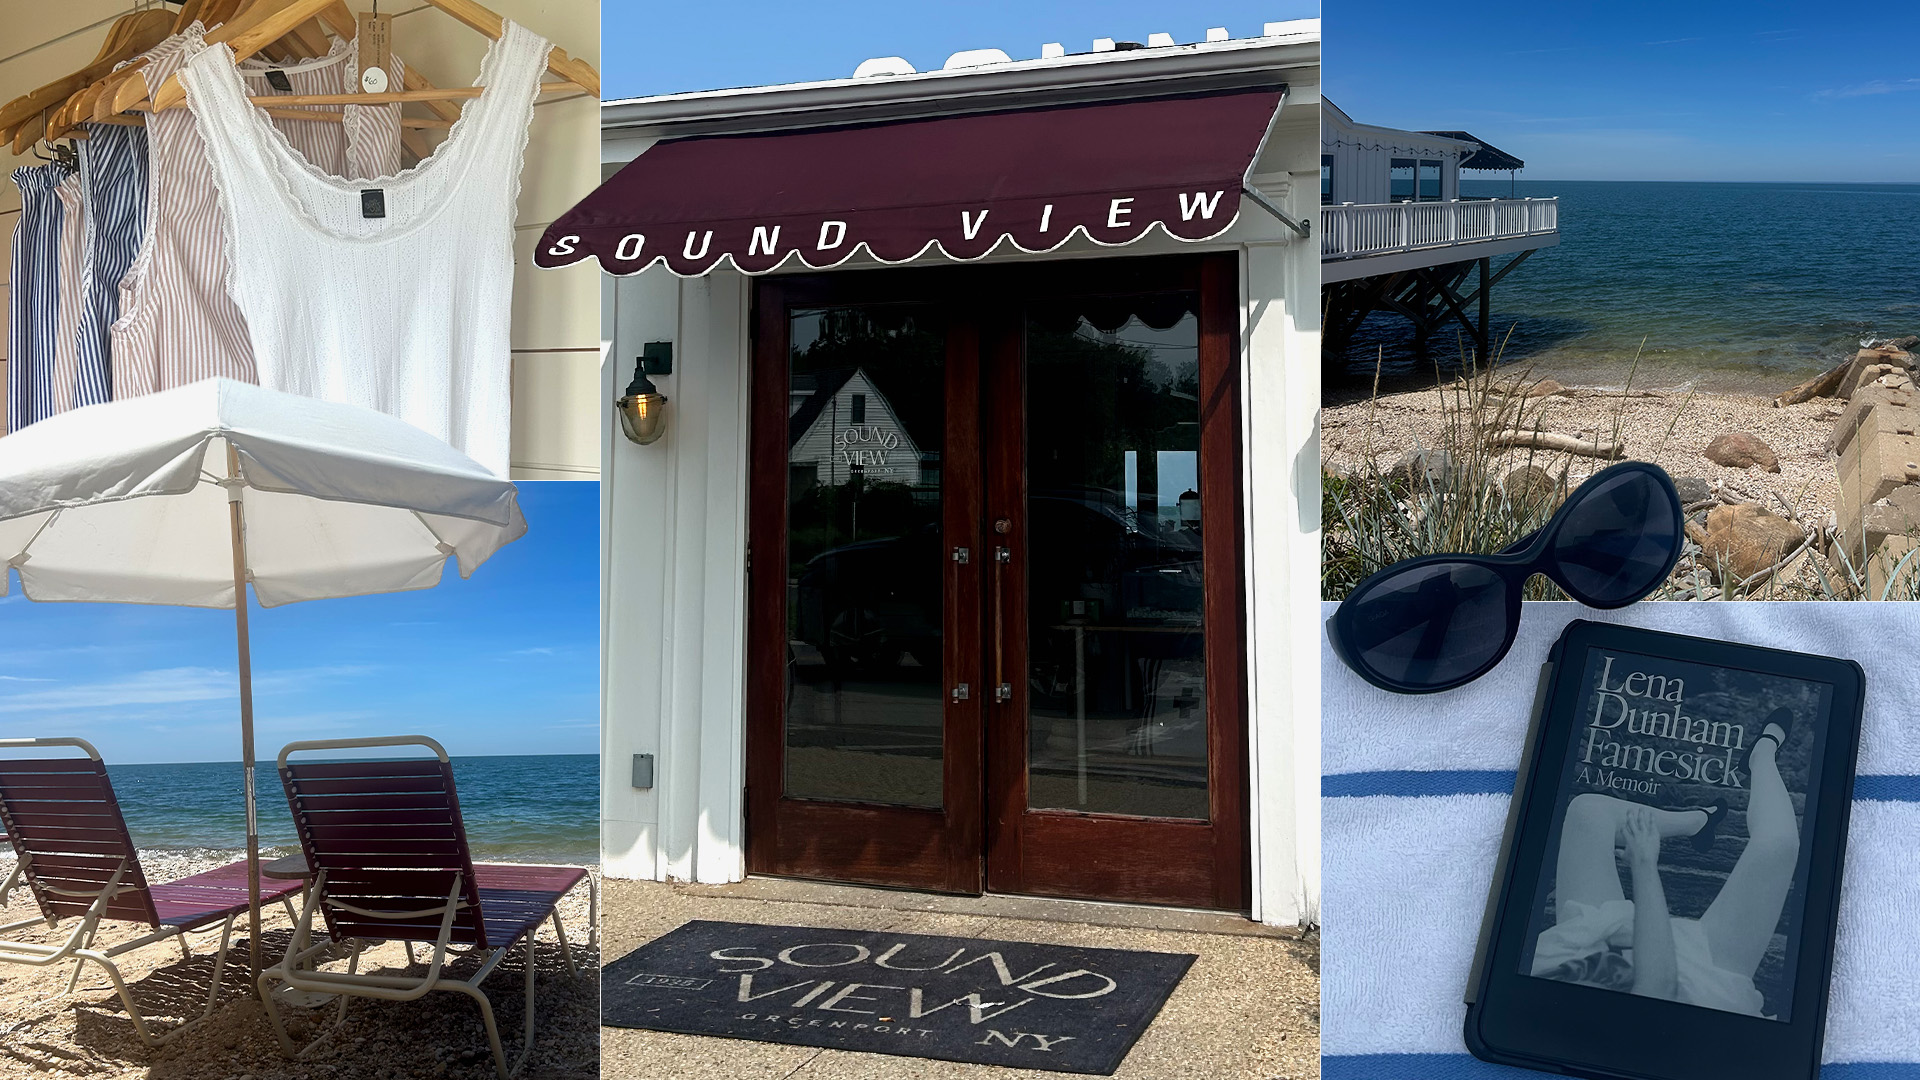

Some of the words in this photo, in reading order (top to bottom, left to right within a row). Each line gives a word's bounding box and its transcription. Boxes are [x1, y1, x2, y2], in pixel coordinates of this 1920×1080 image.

[548, 219, 848, 262] SOUND
[960, 191, 1225, 241] VIEW
[834, 426, 898, 450] SOUND
[843, 450, 889, 466] VIEW
[1596, 656, 1684, 703] Lena
[1589, 691, 1745, 750] Dunham
[1576, 767, 1591, 785] A
[1595, 768, 1662, 795] Memoir
[1581, 727, 1743, 789] Famesick
[709, 943, 1118, 999] SOUND
[736, 974, 1035, 1025] VIEW
[740, 1013, 934, 1038] GREENPORT
[974, 1029, 1077, 1052] NY
